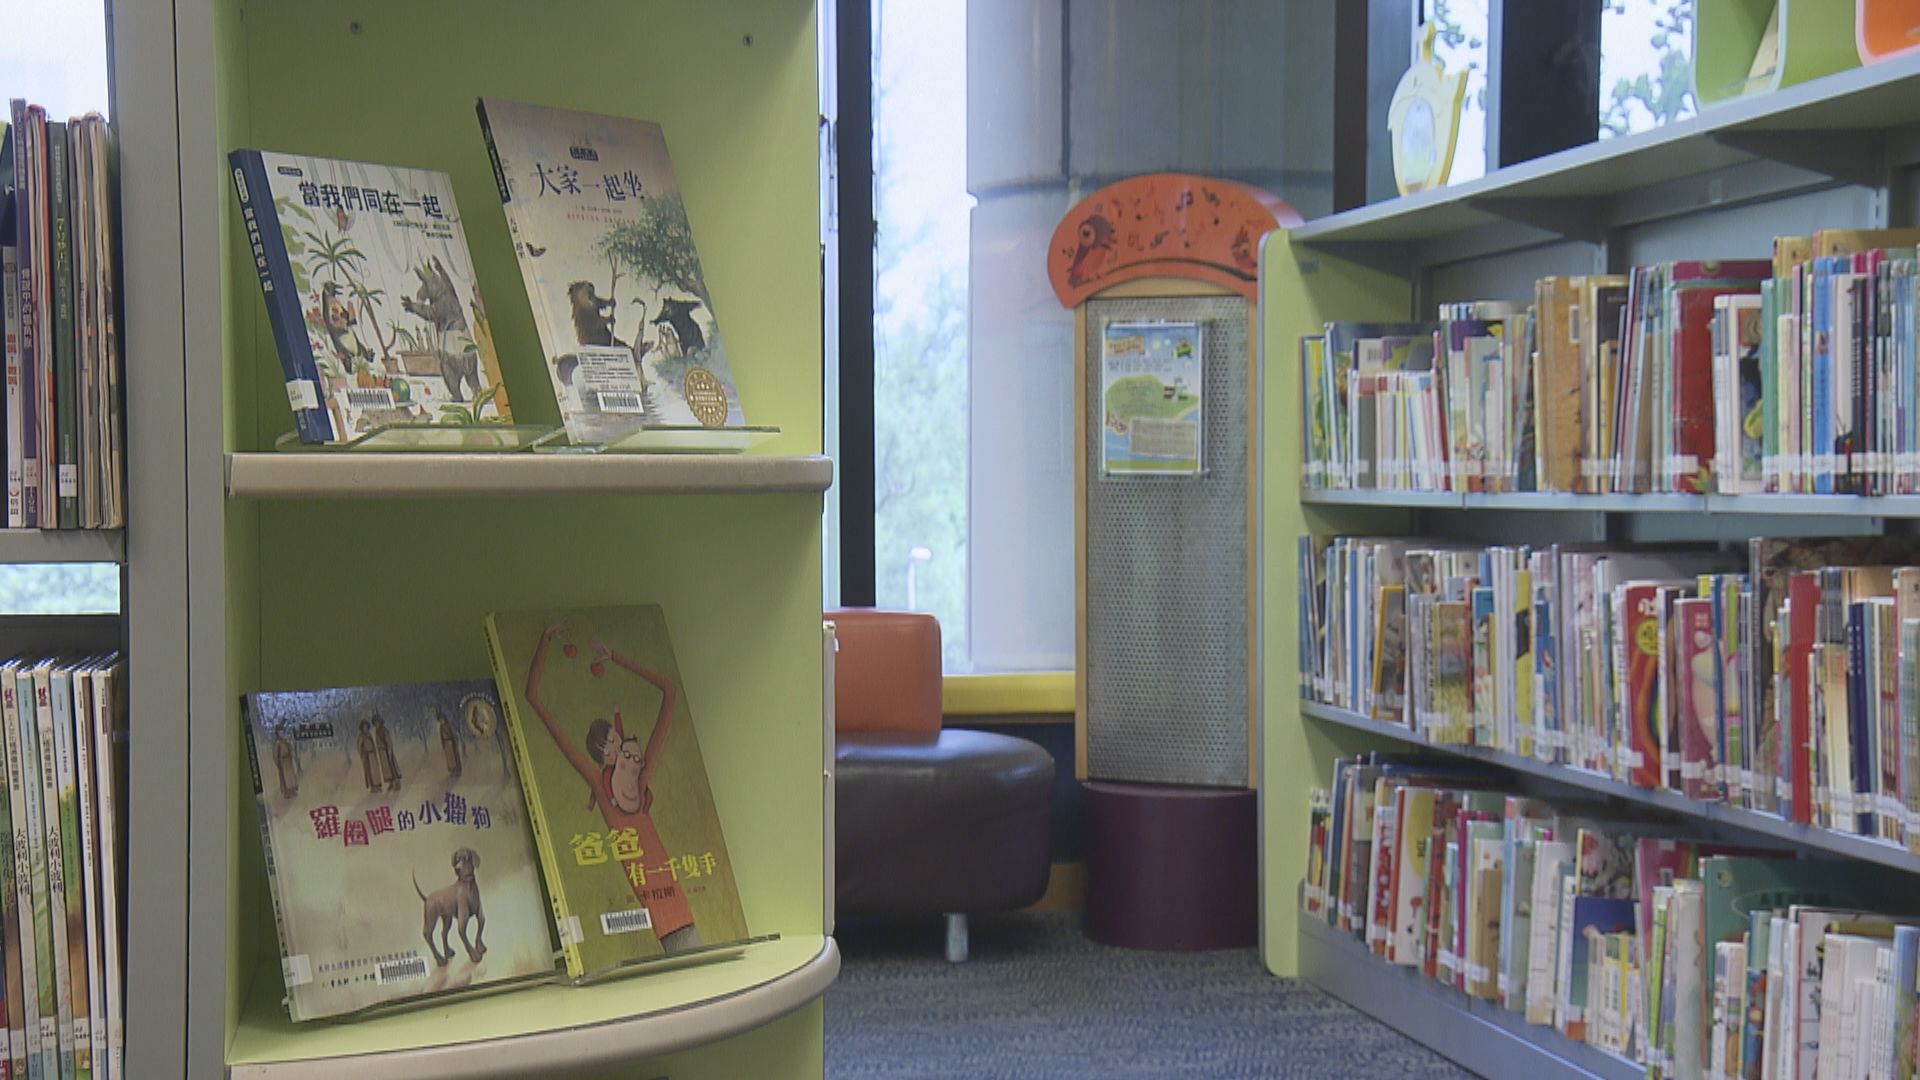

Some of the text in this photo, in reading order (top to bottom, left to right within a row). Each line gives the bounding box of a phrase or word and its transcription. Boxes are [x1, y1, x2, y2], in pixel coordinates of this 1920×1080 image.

[299, 180, 443, 220] 當我們同在一起
[529, 162, 645, 202] 大家一起坐
[309, 792, 491, 848] 羅圈腿的小獵狗
[569, 827, 645, 866] 爸爸
[626, 851, 718, 888] 有一千隻手
